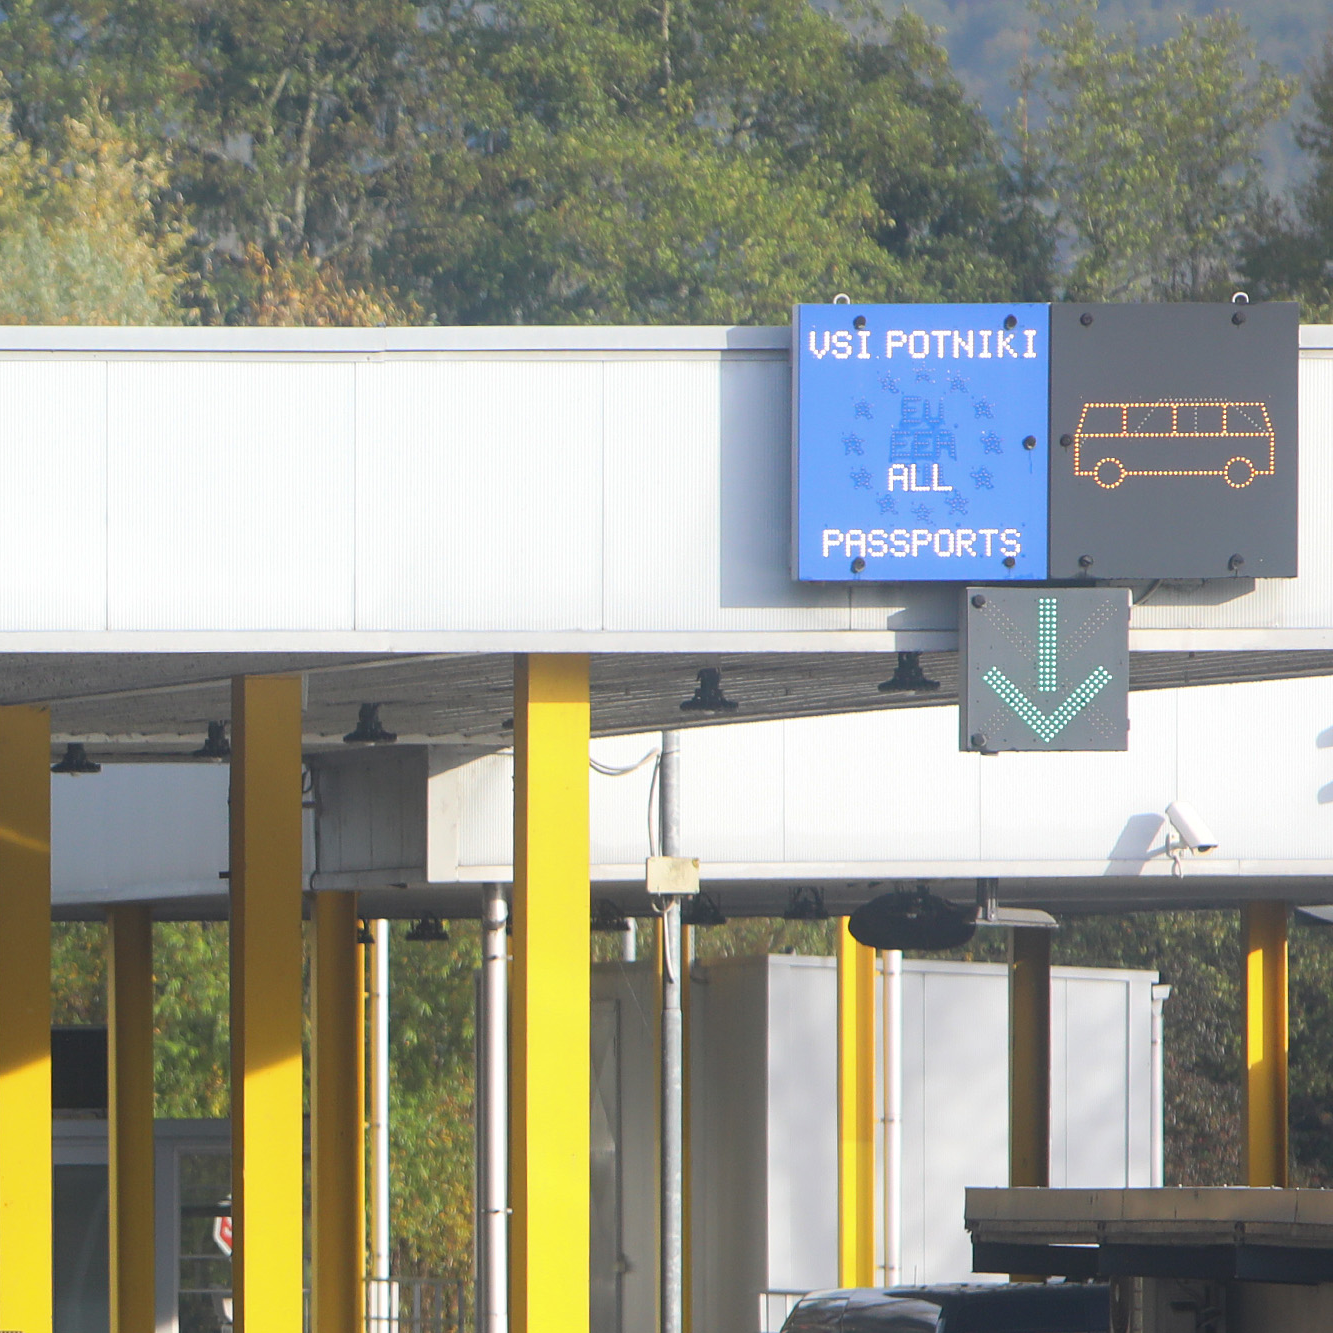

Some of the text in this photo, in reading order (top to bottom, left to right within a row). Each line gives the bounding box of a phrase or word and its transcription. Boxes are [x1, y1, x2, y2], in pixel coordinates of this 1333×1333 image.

[809, 330, 1037, 359] VSI POTNIKI
[902, 396, 944, 425] EU
[891, 430, 956, 458] EEA
[887, 463, 953, 492] ALL
[822, 528, 1022, 557] PASSPORTS
